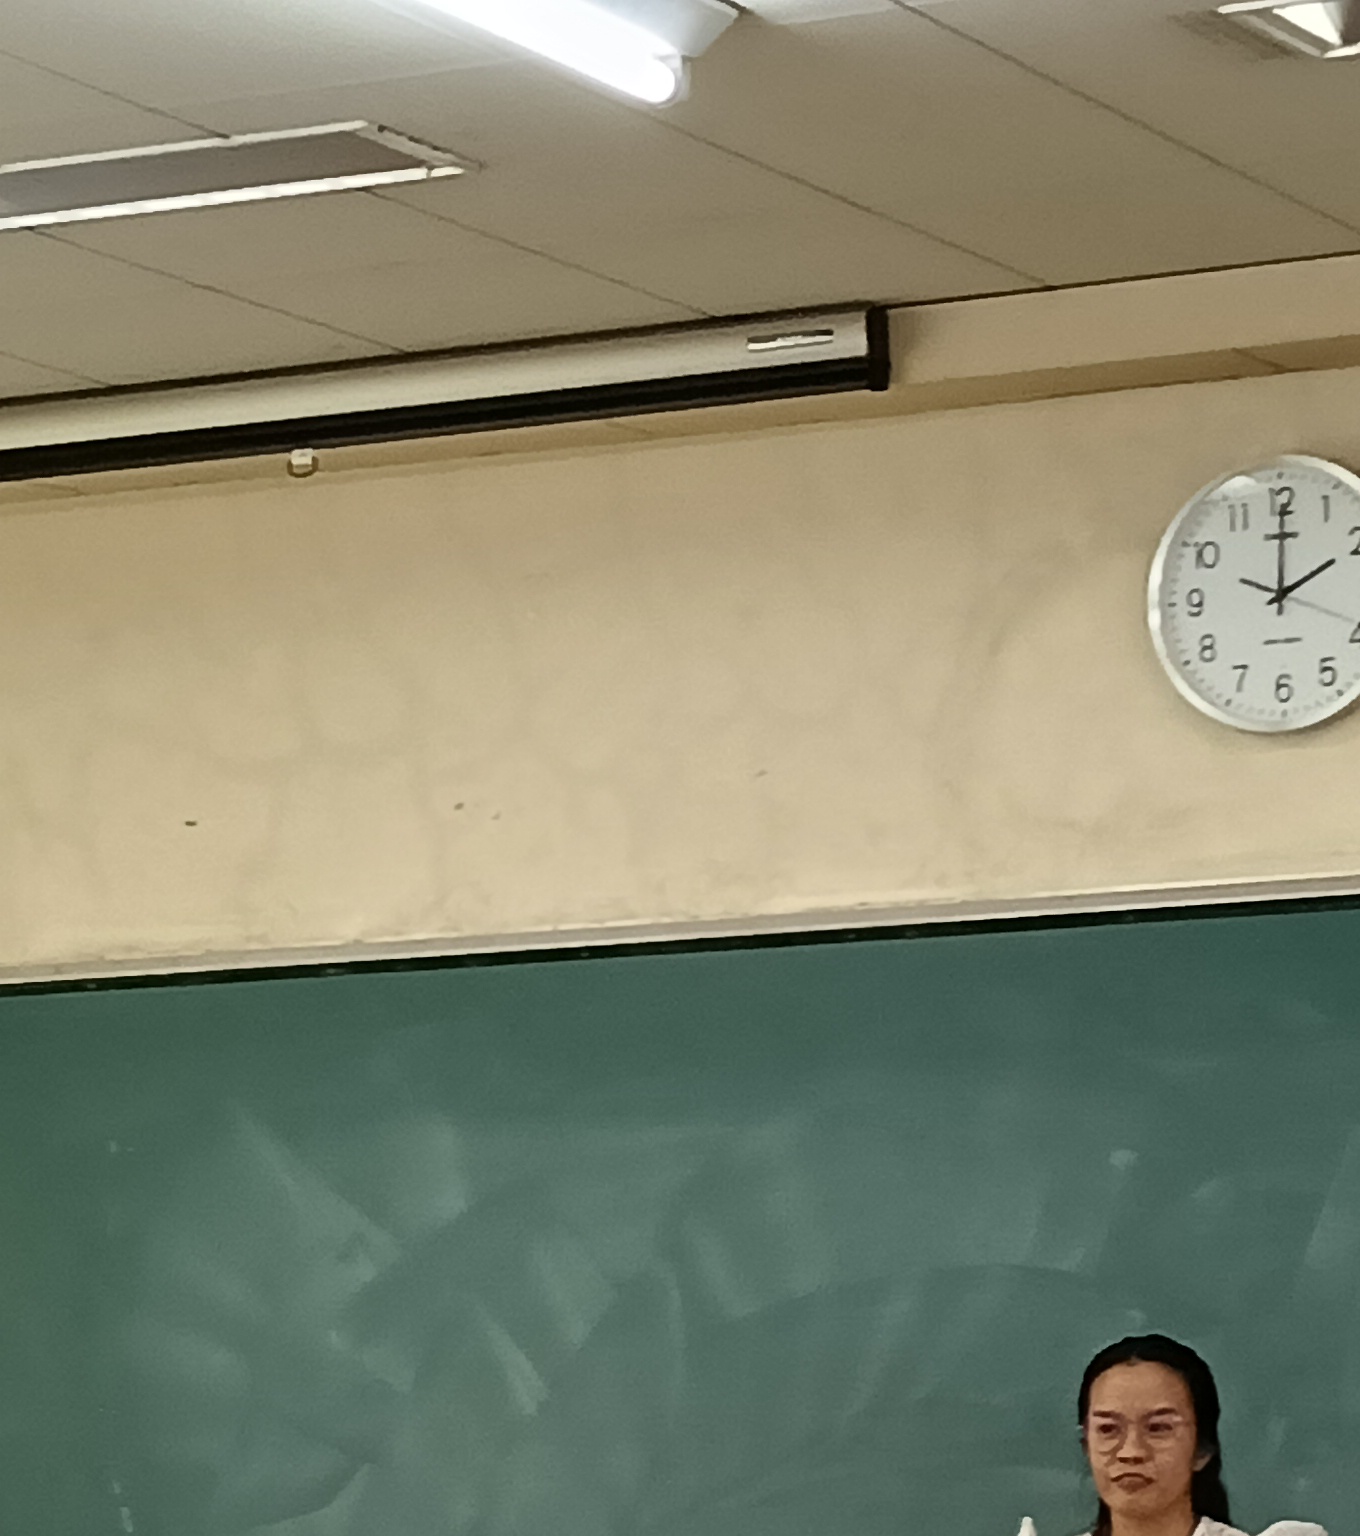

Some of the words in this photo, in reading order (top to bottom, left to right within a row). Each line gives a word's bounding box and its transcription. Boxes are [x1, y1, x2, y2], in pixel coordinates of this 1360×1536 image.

[1268, 486, 1296, 517] 12
[1321, 494, 1331, 523] 1
[1227, 502, 1249, 532] 11
[1194, 541, 1221, 569] 10
[1185, 588, 1205, 617] 9
[1198, 634, 1217, 662] 8
[1232, 664, 1249, 693] 7
[1318, 656, 1337, 687] 5
[1274, 673, 1295, 703] 6
